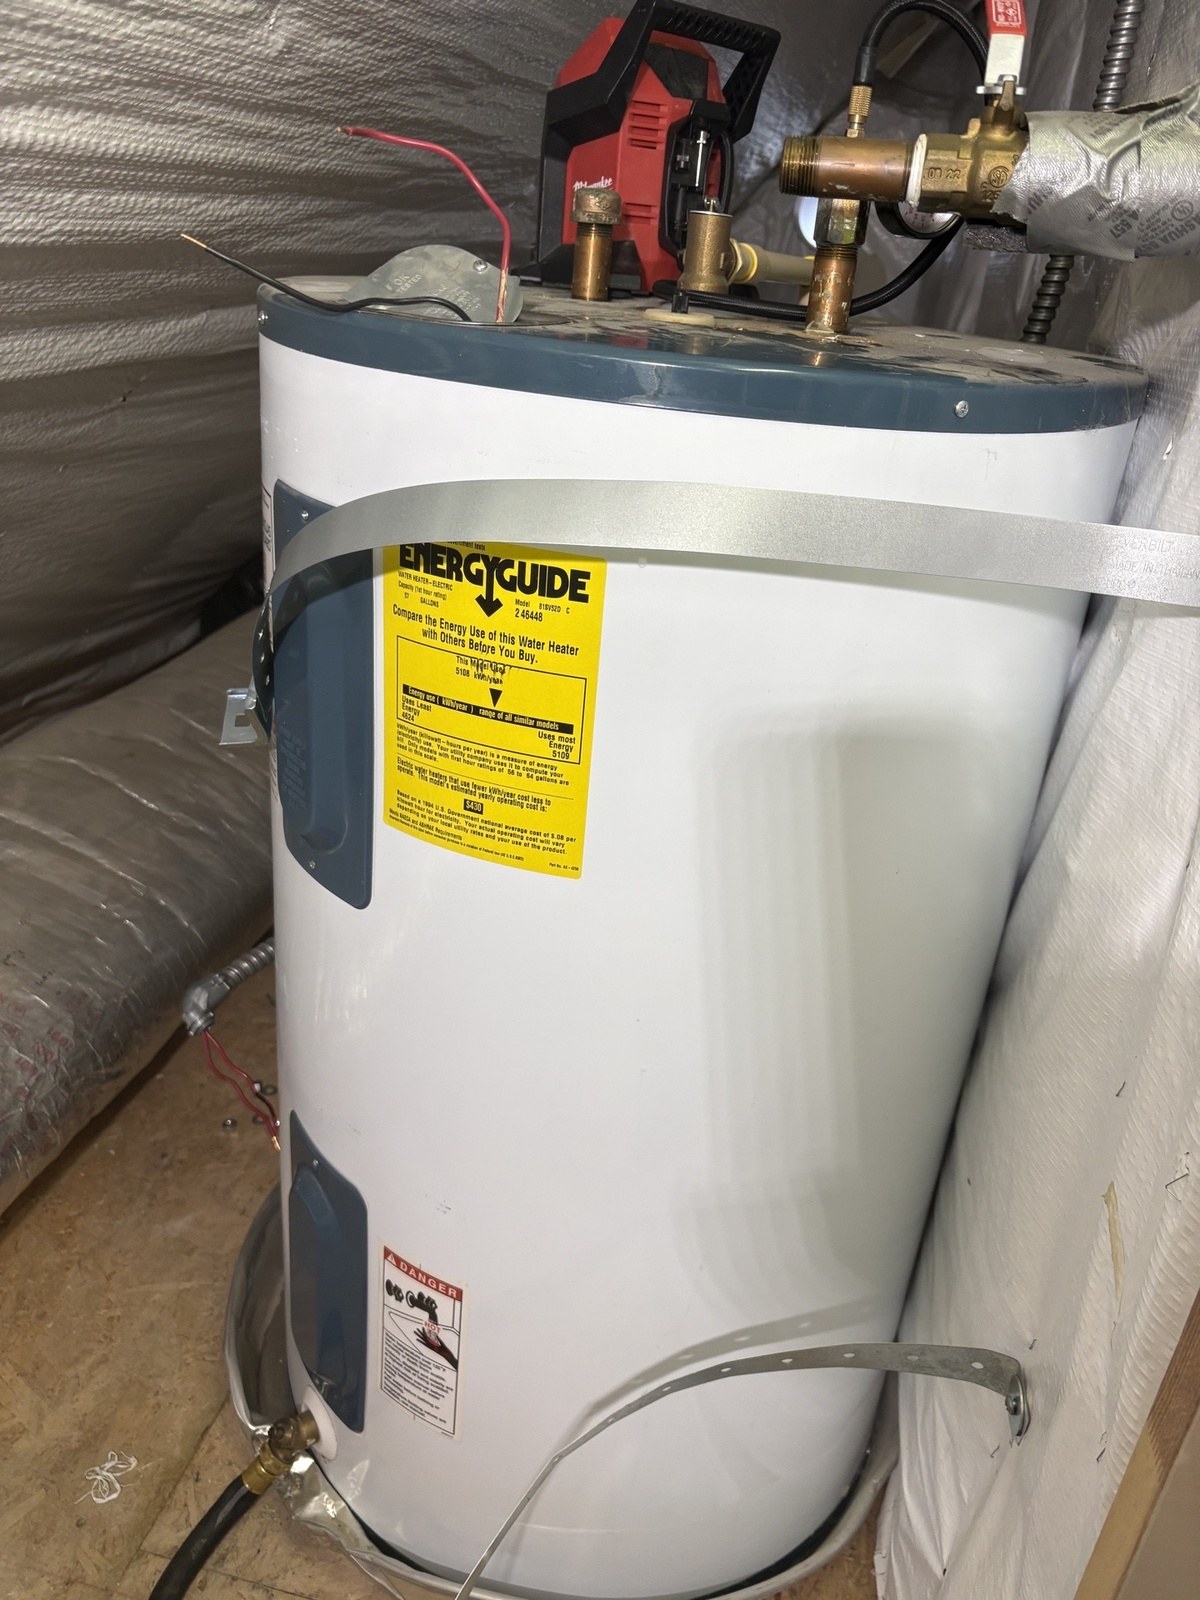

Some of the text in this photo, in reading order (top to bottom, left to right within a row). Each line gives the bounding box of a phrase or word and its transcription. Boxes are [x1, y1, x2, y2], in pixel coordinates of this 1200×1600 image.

[398, 570, 412, 580] WATER
[399, 542, 591, 603] ENERGYGUIDE
[398, 580, 414, 593] Capacity
[423, 587, 433, 596] hour
[420, 597, 439, 608] GALLONS
[515, 598, 530, 608] Model
[392, 603, 579, 656] Compare the Energy Use of this Water Heater
[421, 628, 538, 665] with Others Before You Buy.
[455, 655, 469, 666] This
[455, 666, 470, 678] 5108
[401, 694, 576, 745] Uses Least Uses most
[408, 686, 426, 700] Energy
[426, 694, 436, 703] use
[479, 708, 496, 719] range
[496, 711, 504, 720] of
[504, 713, 513, 722] all
[513, 715, 535, 727] similar
[536, 720, 559, 731] models
[401, 703, 574, 753] Energy Energy
[437, 743, 450, 752] Your
[466, 753, 492, 764] company
[521, 766, 548, 776] compute
[549, 771, 564, 779] your
[462, 745, 473, 753] per
[501, 755, 527, 765] measure
[536, 762, 558, 772] energy
[552, 750, 570, 760] 5109
[462, 758, 476, 766] hour
[535, 774, 558, 784] gallons
[496, 796, 525, 809] operating
[525, 801, 539, 810] cost
[517, 793, 530, 802] cost
[531, 795, 544, 805] less
[447, 808, 480, 823] Government
[504, 824, 528, 835] average
[529, 829, 542, 837] cost
[496, 829, 524, 841] operating
[525, 835, 538, 843] cost
[551, 841, 566, 849] vary
[400, 1261, 457, 1298] DANGER
